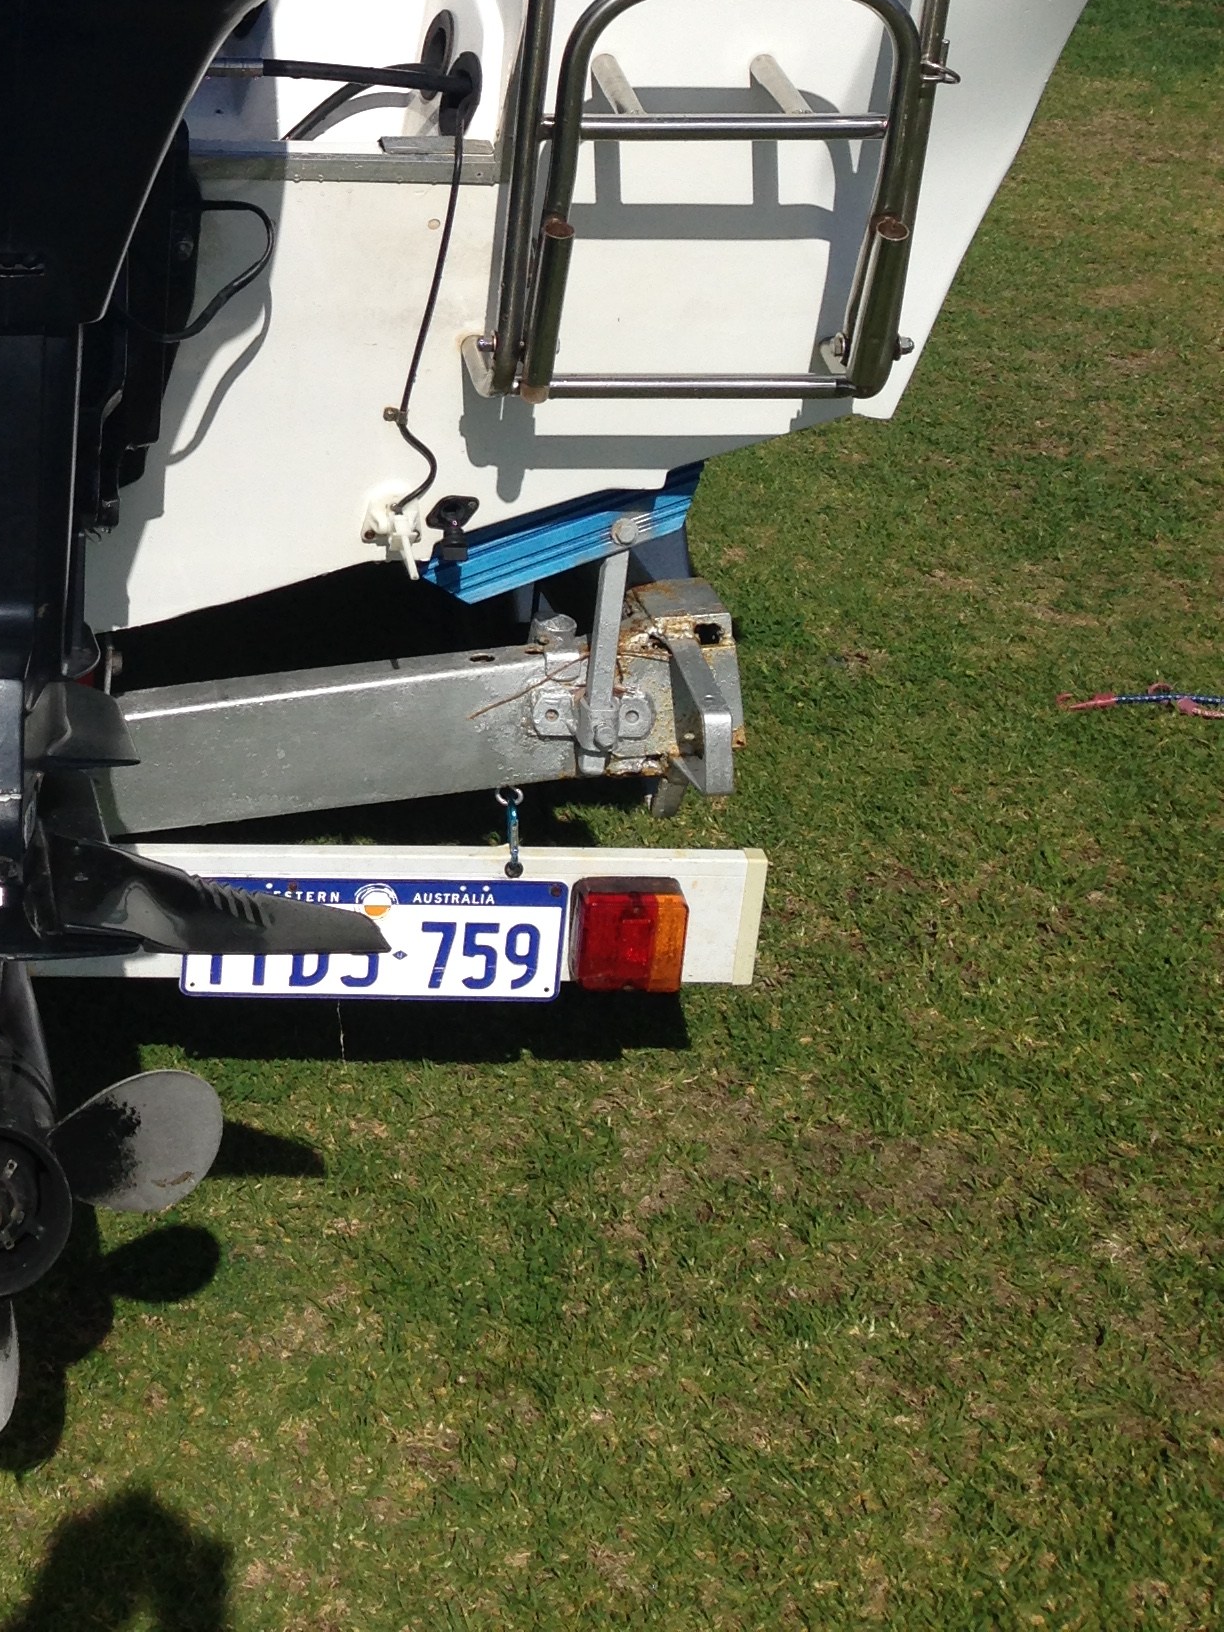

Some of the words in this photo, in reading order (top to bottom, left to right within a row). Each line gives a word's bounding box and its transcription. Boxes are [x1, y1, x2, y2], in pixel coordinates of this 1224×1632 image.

[272, 890, 341, 904] STERN
[412, 892, 496, 905] AUSTRALIA
[421, 921, 541, 990] 759
